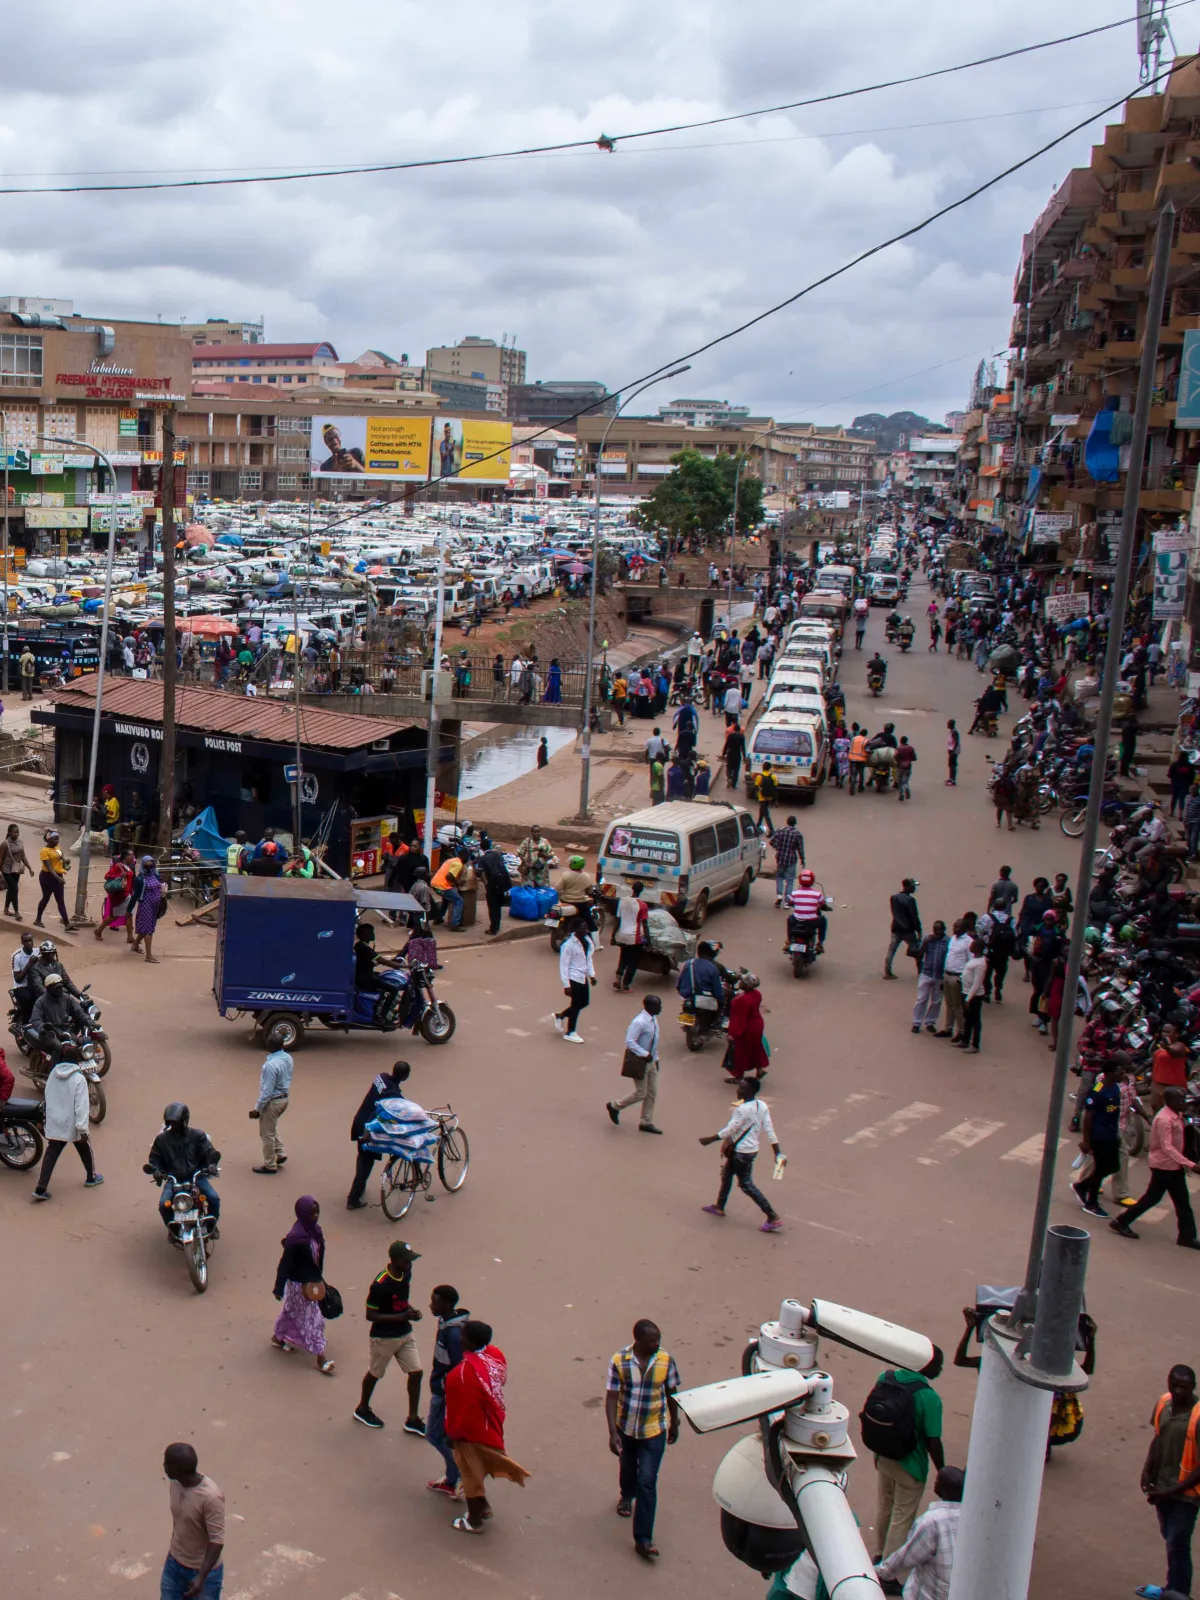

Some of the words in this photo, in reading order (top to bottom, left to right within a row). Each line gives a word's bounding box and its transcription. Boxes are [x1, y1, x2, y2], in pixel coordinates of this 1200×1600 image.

[56, 374, 98, 386] FREEMAN
[101, 376, 163, 389] HYPERMARKET
[86, 388, 134, 399] 2ND-FLOOR
[136, 392, 166, 400] Wholesale
[120, 408, 138, 418] TIENS
[145, 452, 184, 460] TIES
[1048, 600, 1086, 609] PARKING
[115, 723, 149, 738] NAKIVUBO
[205, 738, 225, 750] POLICE
[227, 742, 242, 753] POST
[247, 992, 322, 1002] ZONGSHEN
